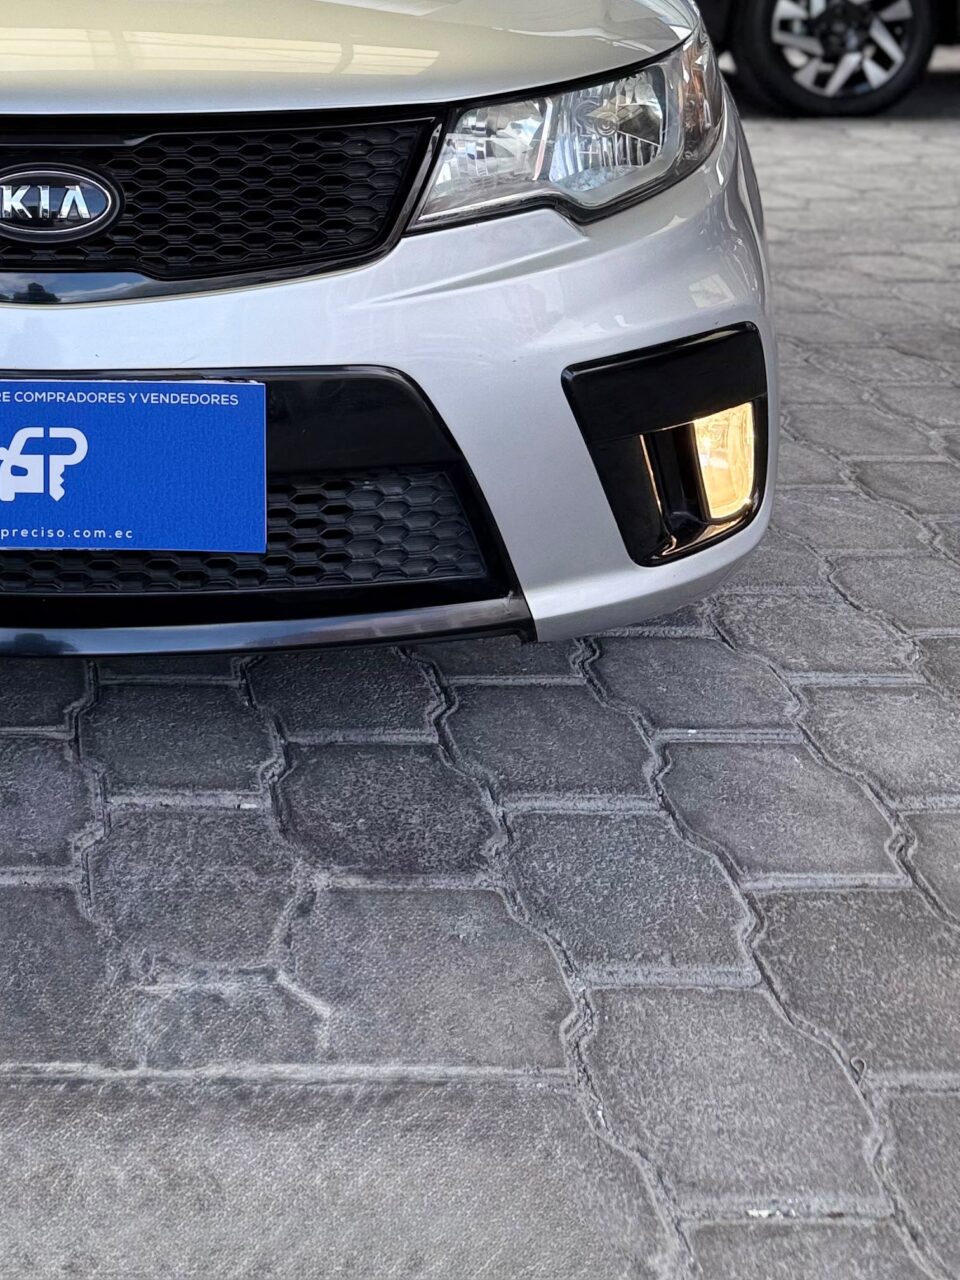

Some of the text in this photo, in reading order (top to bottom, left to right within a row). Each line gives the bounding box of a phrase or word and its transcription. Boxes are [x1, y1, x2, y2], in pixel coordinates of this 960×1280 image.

[0, 184, 91, 219] KIA
[14, 391, 125, 404] COMPRADORES
[129, 392, 139, 404] Y
[140, 392, 239, 406] VENDEDORES
